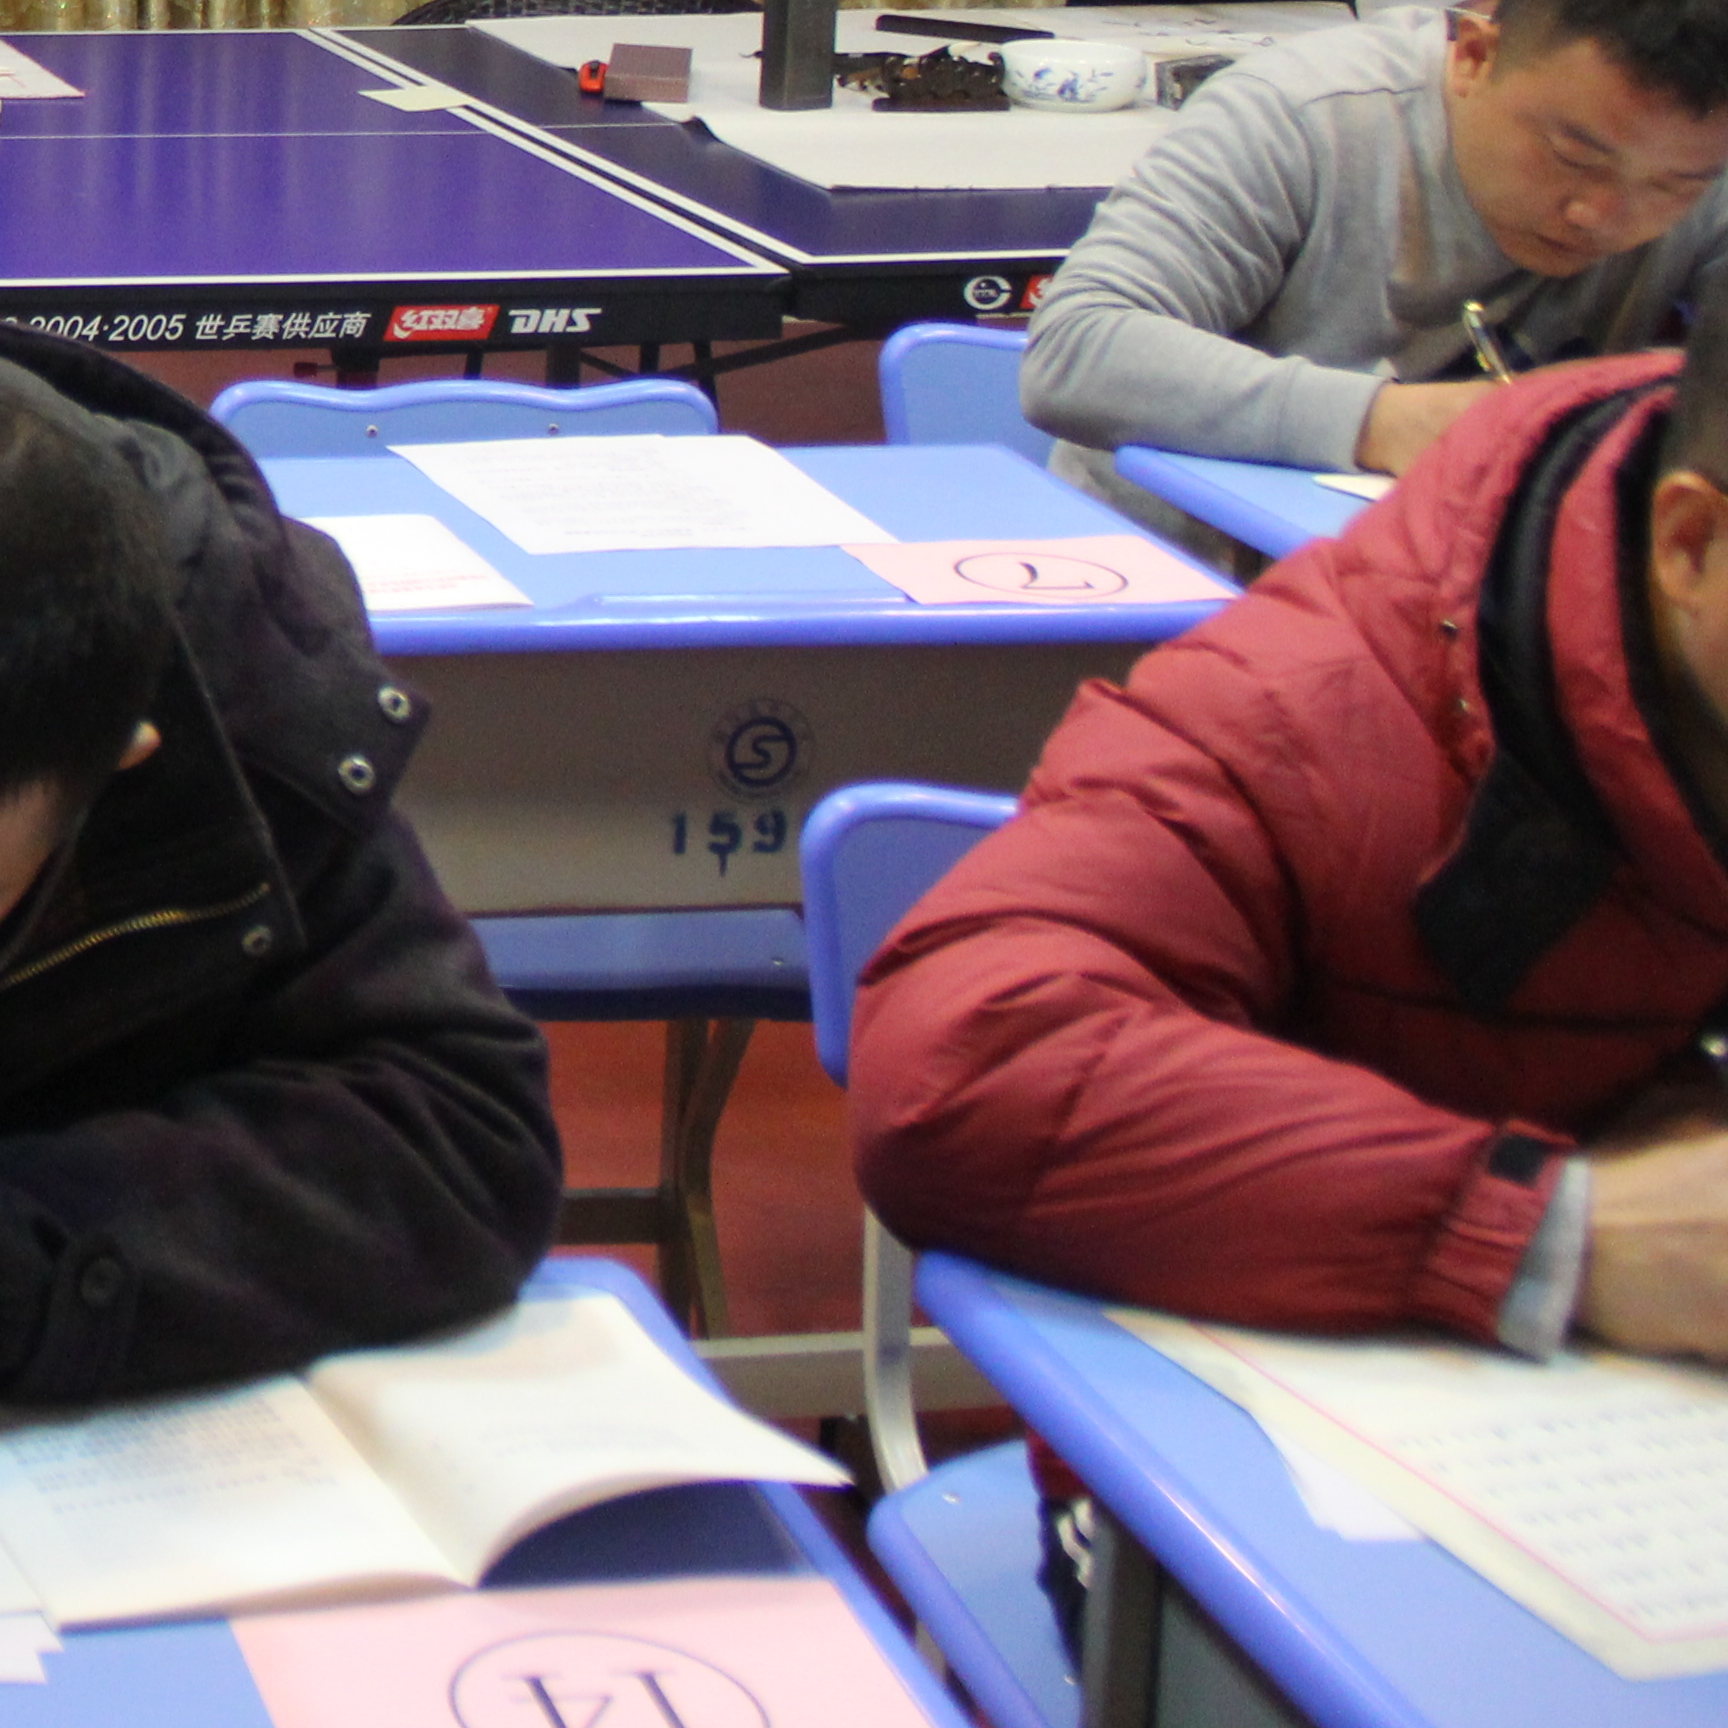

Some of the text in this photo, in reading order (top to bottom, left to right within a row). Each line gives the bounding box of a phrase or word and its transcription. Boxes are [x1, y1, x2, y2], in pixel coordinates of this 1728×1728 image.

[194, 311, 372, 341] 世乒赛供应商
[507, 306, 603, 334] DHS
[672, 809, 788, 862] 159
